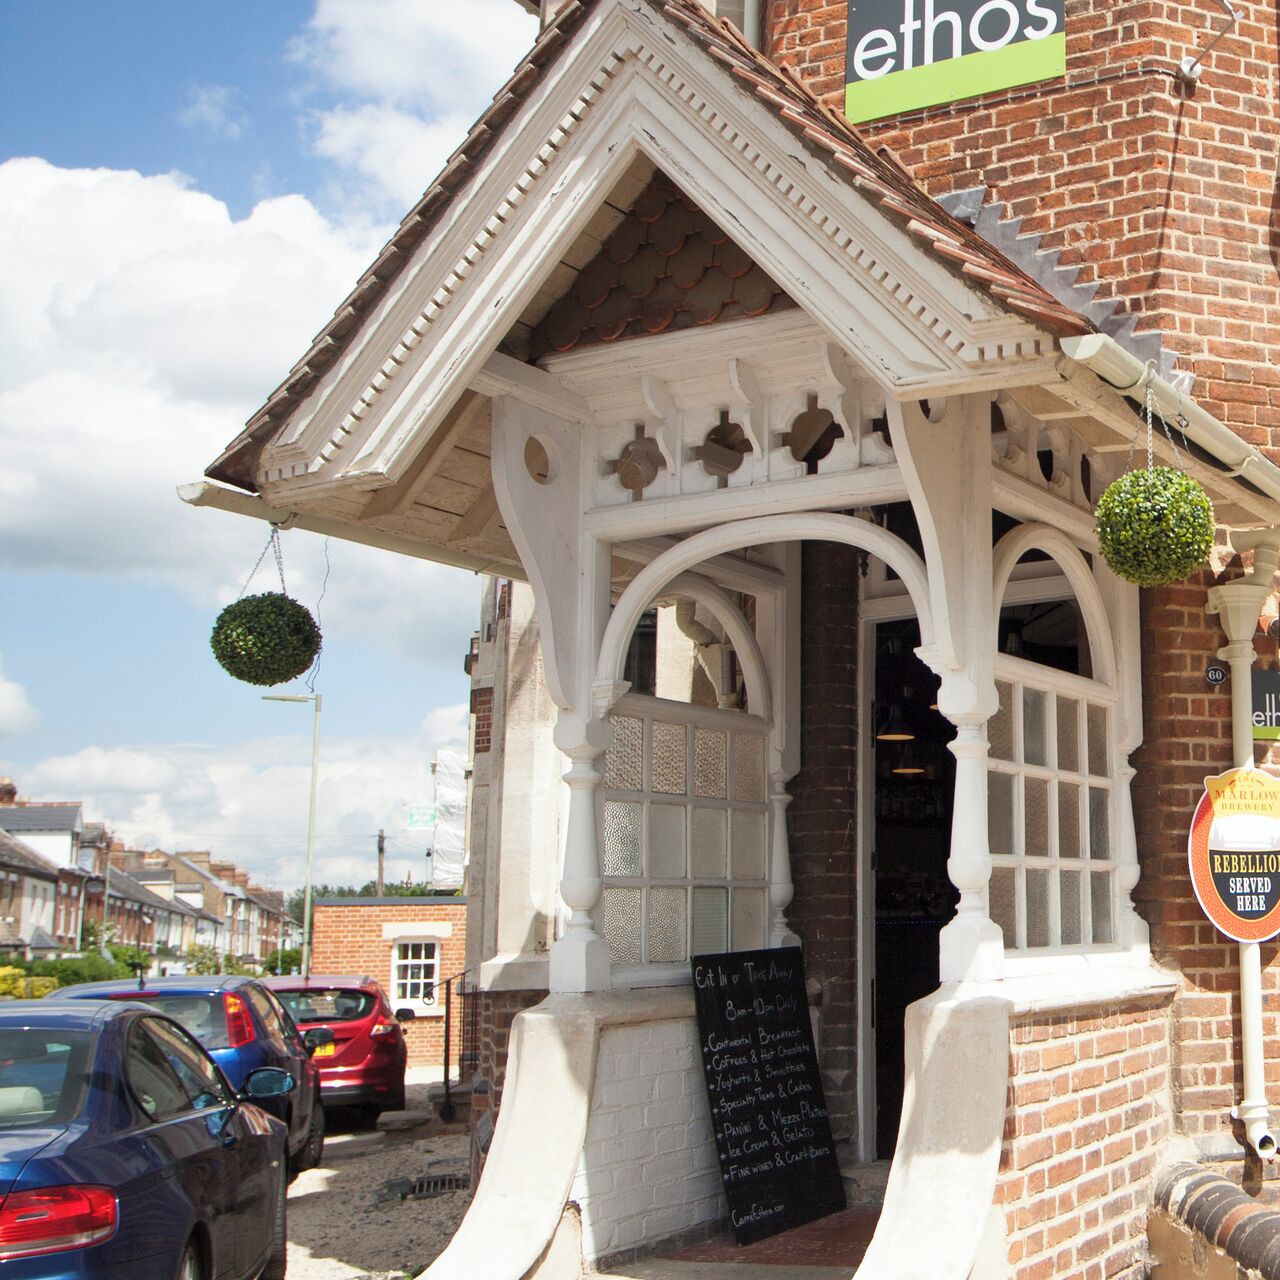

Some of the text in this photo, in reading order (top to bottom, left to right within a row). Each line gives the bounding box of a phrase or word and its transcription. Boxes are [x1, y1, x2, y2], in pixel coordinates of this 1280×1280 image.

[1207, 670, 1223, 681] 60
[1214, 789, 1280, 801] MARLOW
[1221, 802, 1275, 812] BREWERY
[1229, 877, 1272, 894] SERVED
[1236, 895, 1266, 912] HERE
[750, 1049, 759, 1064] &
[754, 1068, 761, 1083] &
[777, 1082, 787, 1099] &
[758, 1113, 770, 1131] &
[770, 1130, 785, 1147] &
[774, 1152, 786, 1167] &
